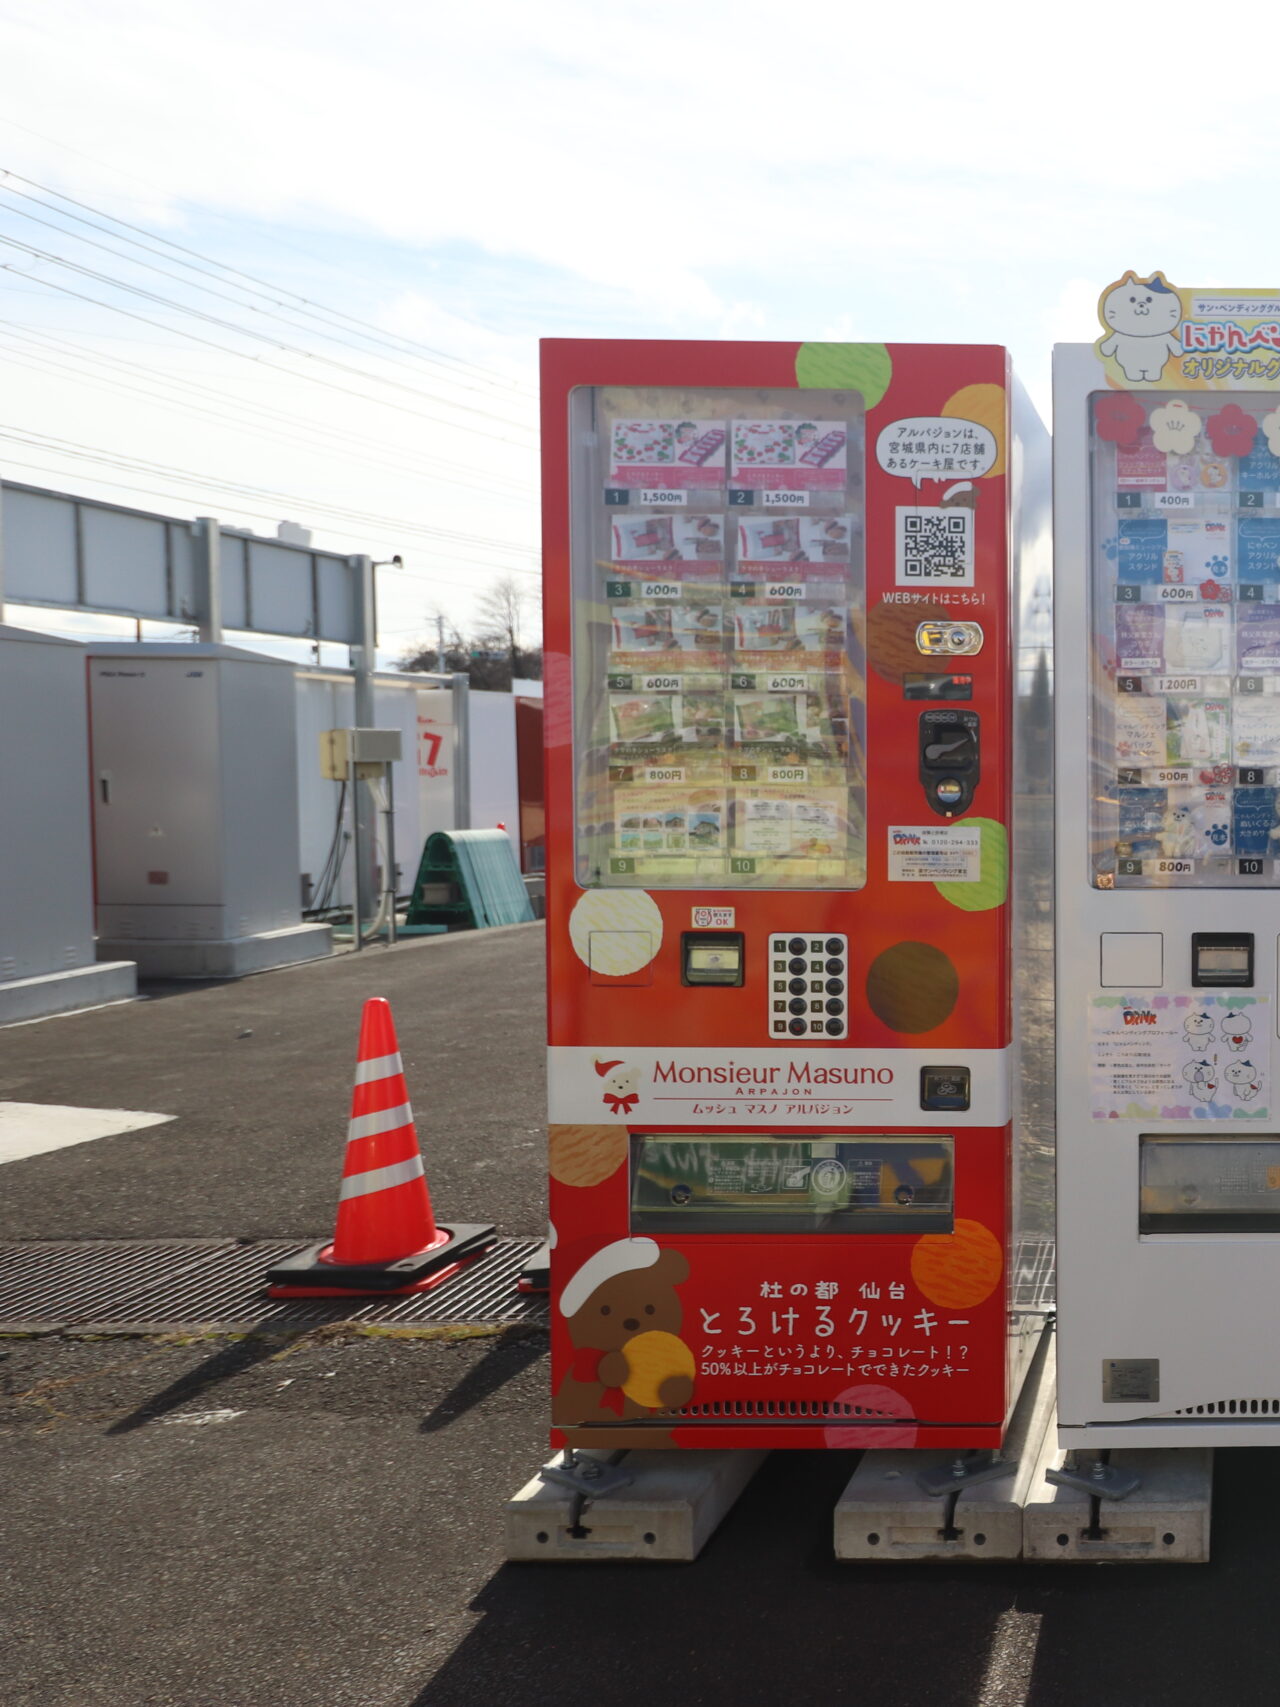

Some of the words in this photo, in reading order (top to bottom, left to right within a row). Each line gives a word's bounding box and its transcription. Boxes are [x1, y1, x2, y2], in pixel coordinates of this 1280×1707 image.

[888, 442, 986, 456] 宮城県内に7店舗
[886, 458, 986, 471] あるケーキ屋です。
[642, 492, 683, 503] 1,500円
[765, 494, 805, 504] 1,500円
[1160, 496, 1189, 505] 400円
[1128, 553, 1158, 561] アクリル
[1128, 563, 1157, 571] スタンド
[645, 585, 678, 596] 600円
[769, 586, 802, 597] 600円
[1161, 588, 1193, 599] 600円
[646, 677, 679, 688] 600円
[771, 677, 804, 688] 600円
[649, 770, 682, 781] 800円
[771, 769, 804, 780] 800円
[1159, 772, 1188, 782] 900円
[1159, 862, 1191, 873] 800円
[715, 918, 729, 926] OK
[1123, 1009, 1157, 1025] DRINK
[653, 1060, 780, 1085] Monsieur
[787, 1062, 894, 1085] Masuno
[735, 1086, 813, 1096] ARPAJON
[692, 1103, 737, 1115] ムッシュ
[744, 1103, 777, 1115] マスノ
[760, 1281, 839, 1300] 杜の都
[858, 1282, 906, 1300] 仙台
[700, 1306, 970, 1337] とろけるクッキー
